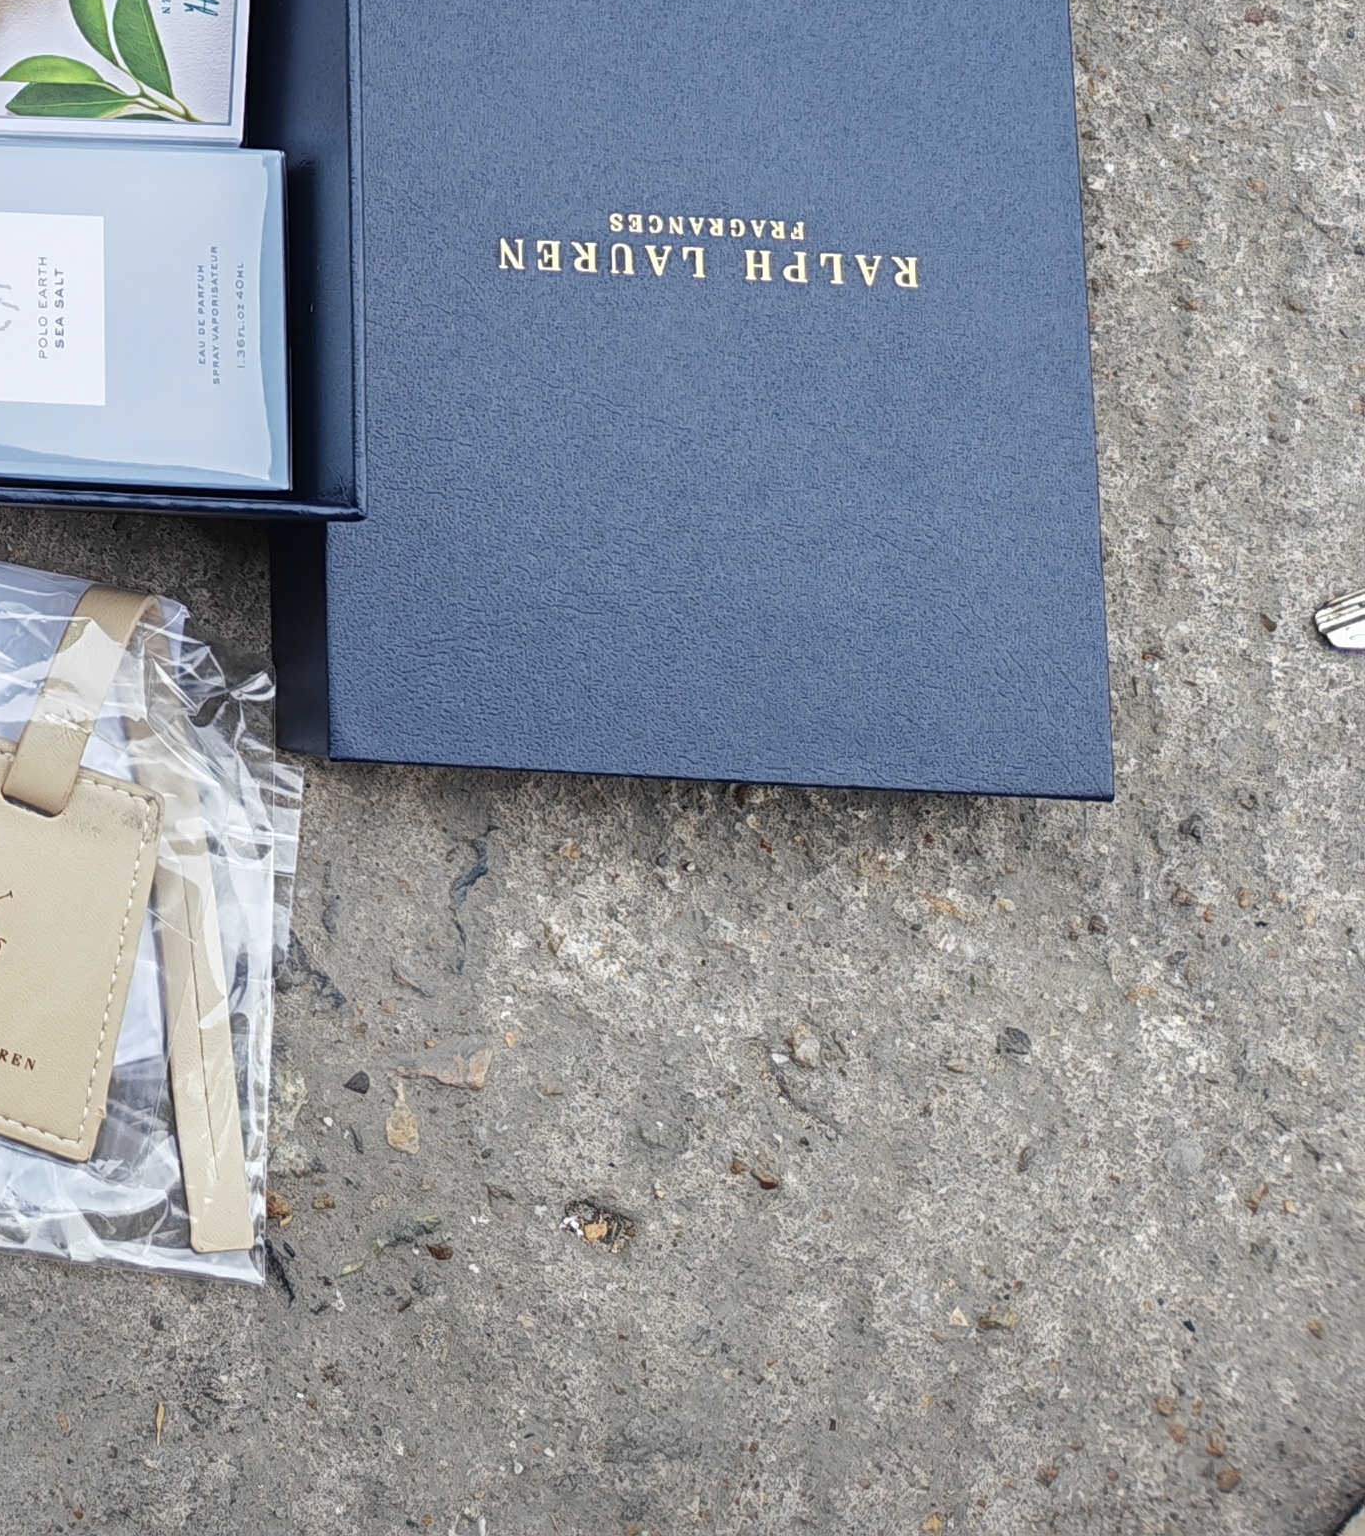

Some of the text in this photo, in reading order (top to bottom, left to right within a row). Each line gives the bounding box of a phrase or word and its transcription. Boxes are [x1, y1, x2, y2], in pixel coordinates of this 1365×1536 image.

[497, 235, 920, 289] RALPH LAUREN
[609, 213, 805, 240] FRAGRANCES
[38, 256, 48, 359] POLO EARTH
[54, 268, 64, 349] SEA SALT
[197, 264, 206, 365] EAU DE PARFUM
[210, 246, 220, 385] SPRAY VAPORISATEUR
[235, 262, 244, 300] 40ML
